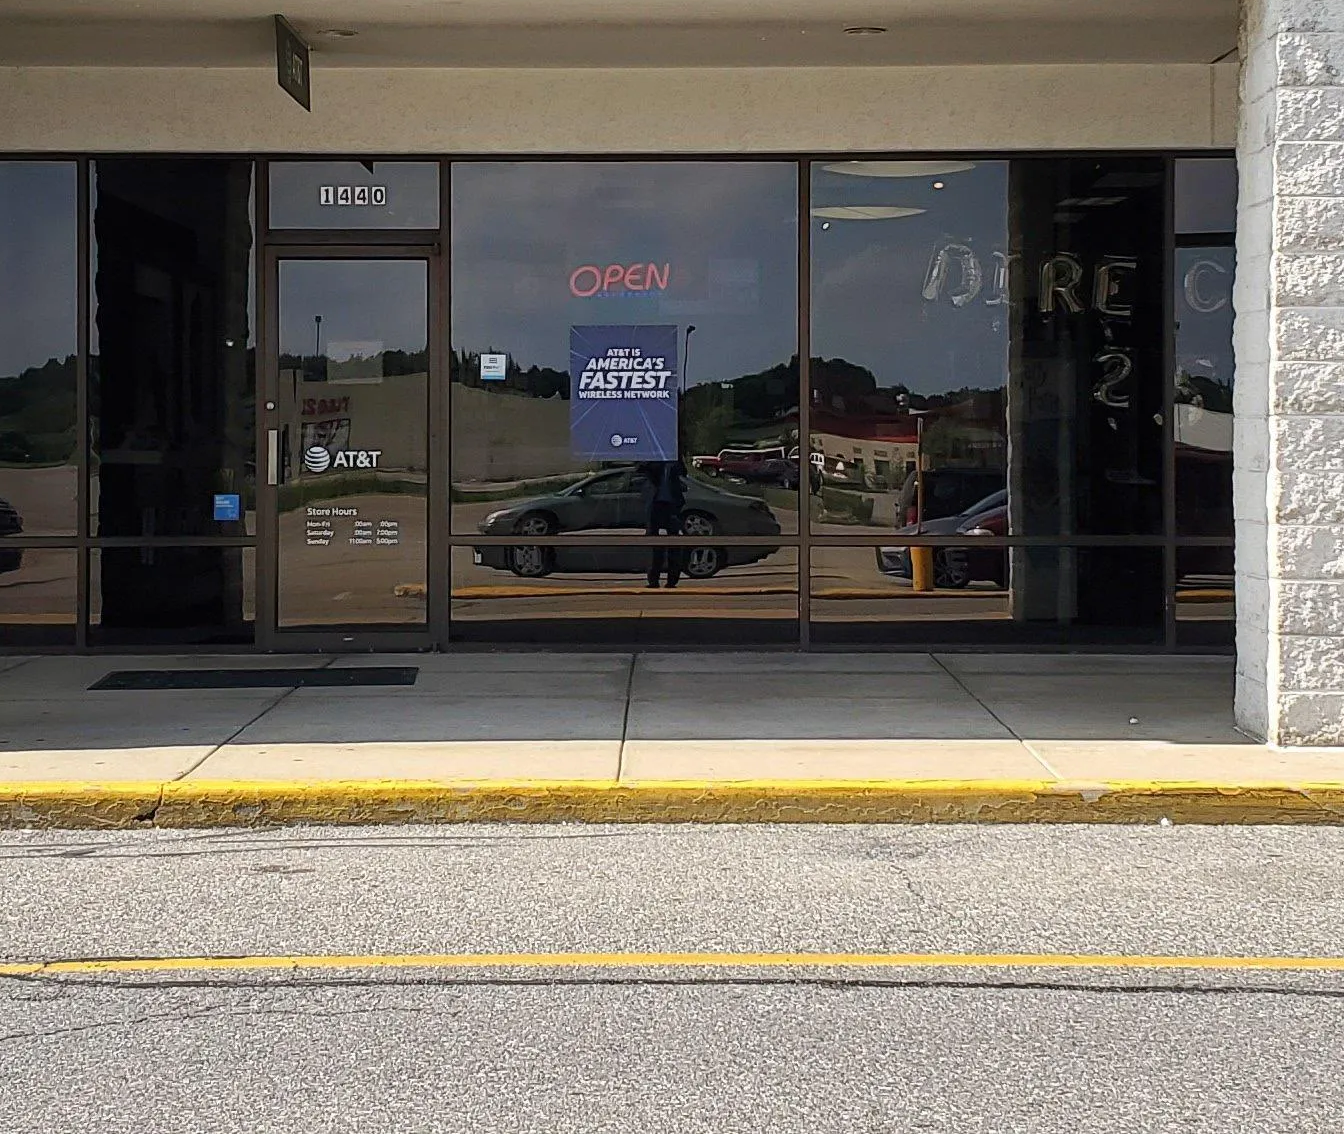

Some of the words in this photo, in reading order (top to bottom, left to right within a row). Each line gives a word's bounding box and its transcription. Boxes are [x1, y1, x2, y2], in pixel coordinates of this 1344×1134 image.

[321, 186, 385, 205] 1440
[570, 263, 669, 296] OPEN
[607, 349, 630, 357] AT&T
[586, 357, 665, 370] AMERICA'S
[579, 371, 671, 389] FASTEST
[579, 390, 622, 398] WIRELESS
[624, 390, 669, 398] NETWORK
[333, 451, 381, 467] AT&T
[307, 507, 330, 516] Store
[332, 507, 357, 516] Hours
